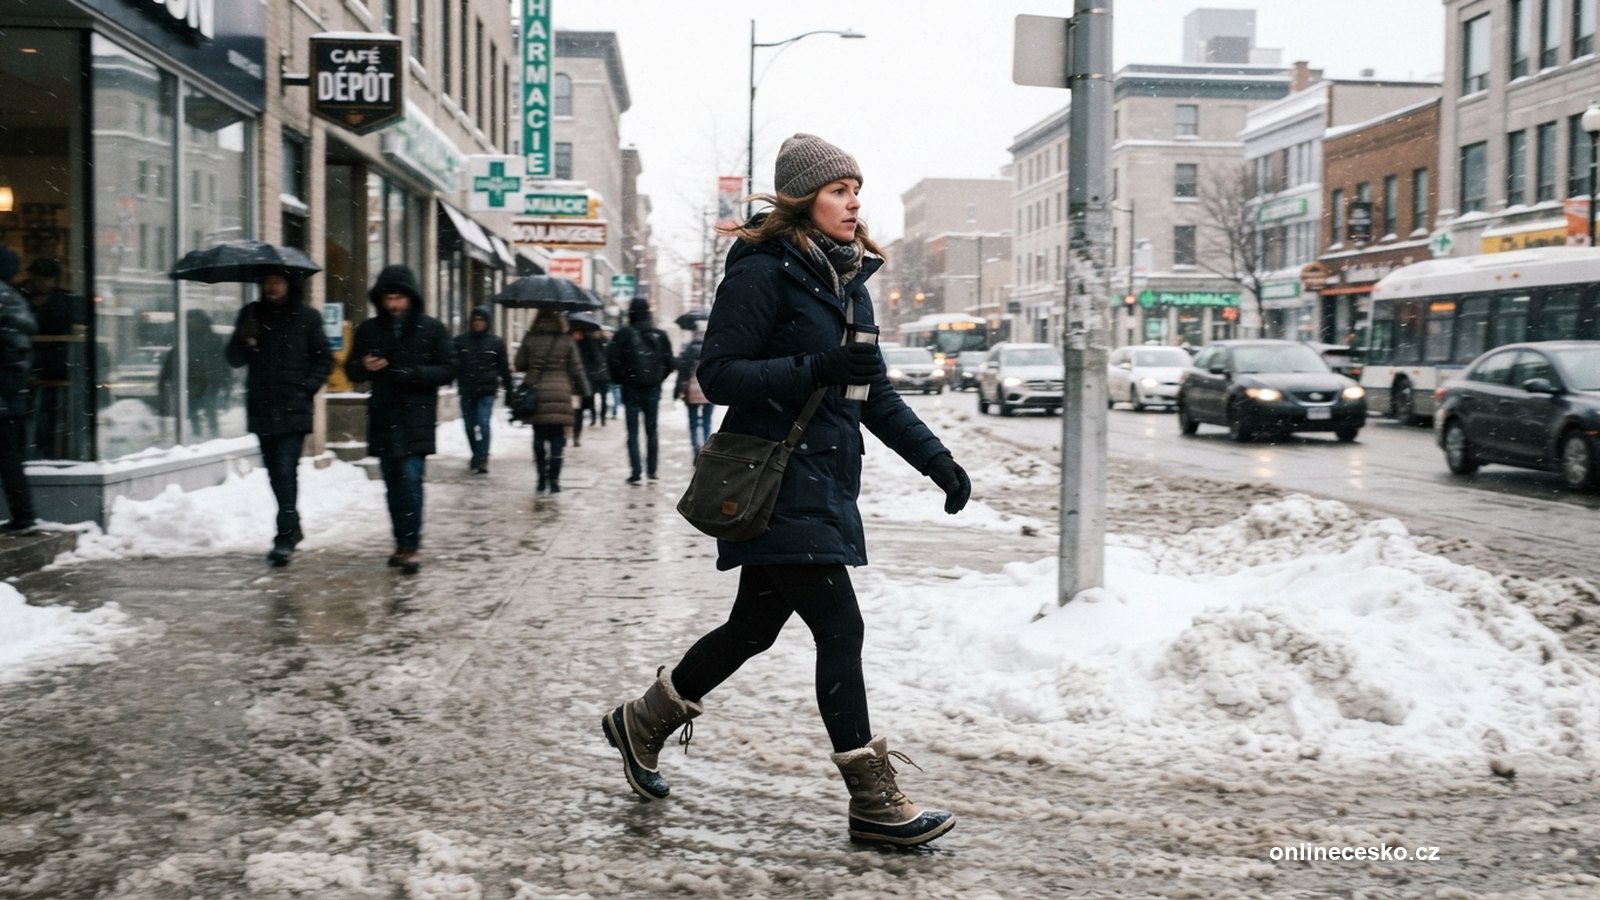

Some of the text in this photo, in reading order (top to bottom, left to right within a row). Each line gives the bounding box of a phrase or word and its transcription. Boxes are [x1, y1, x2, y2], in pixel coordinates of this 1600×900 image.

[330, 46, 381, 64] CAFÉ
[318, 65, 395, 102] DÉPÔT
[526, 0, 547, 173] HARMACIE
